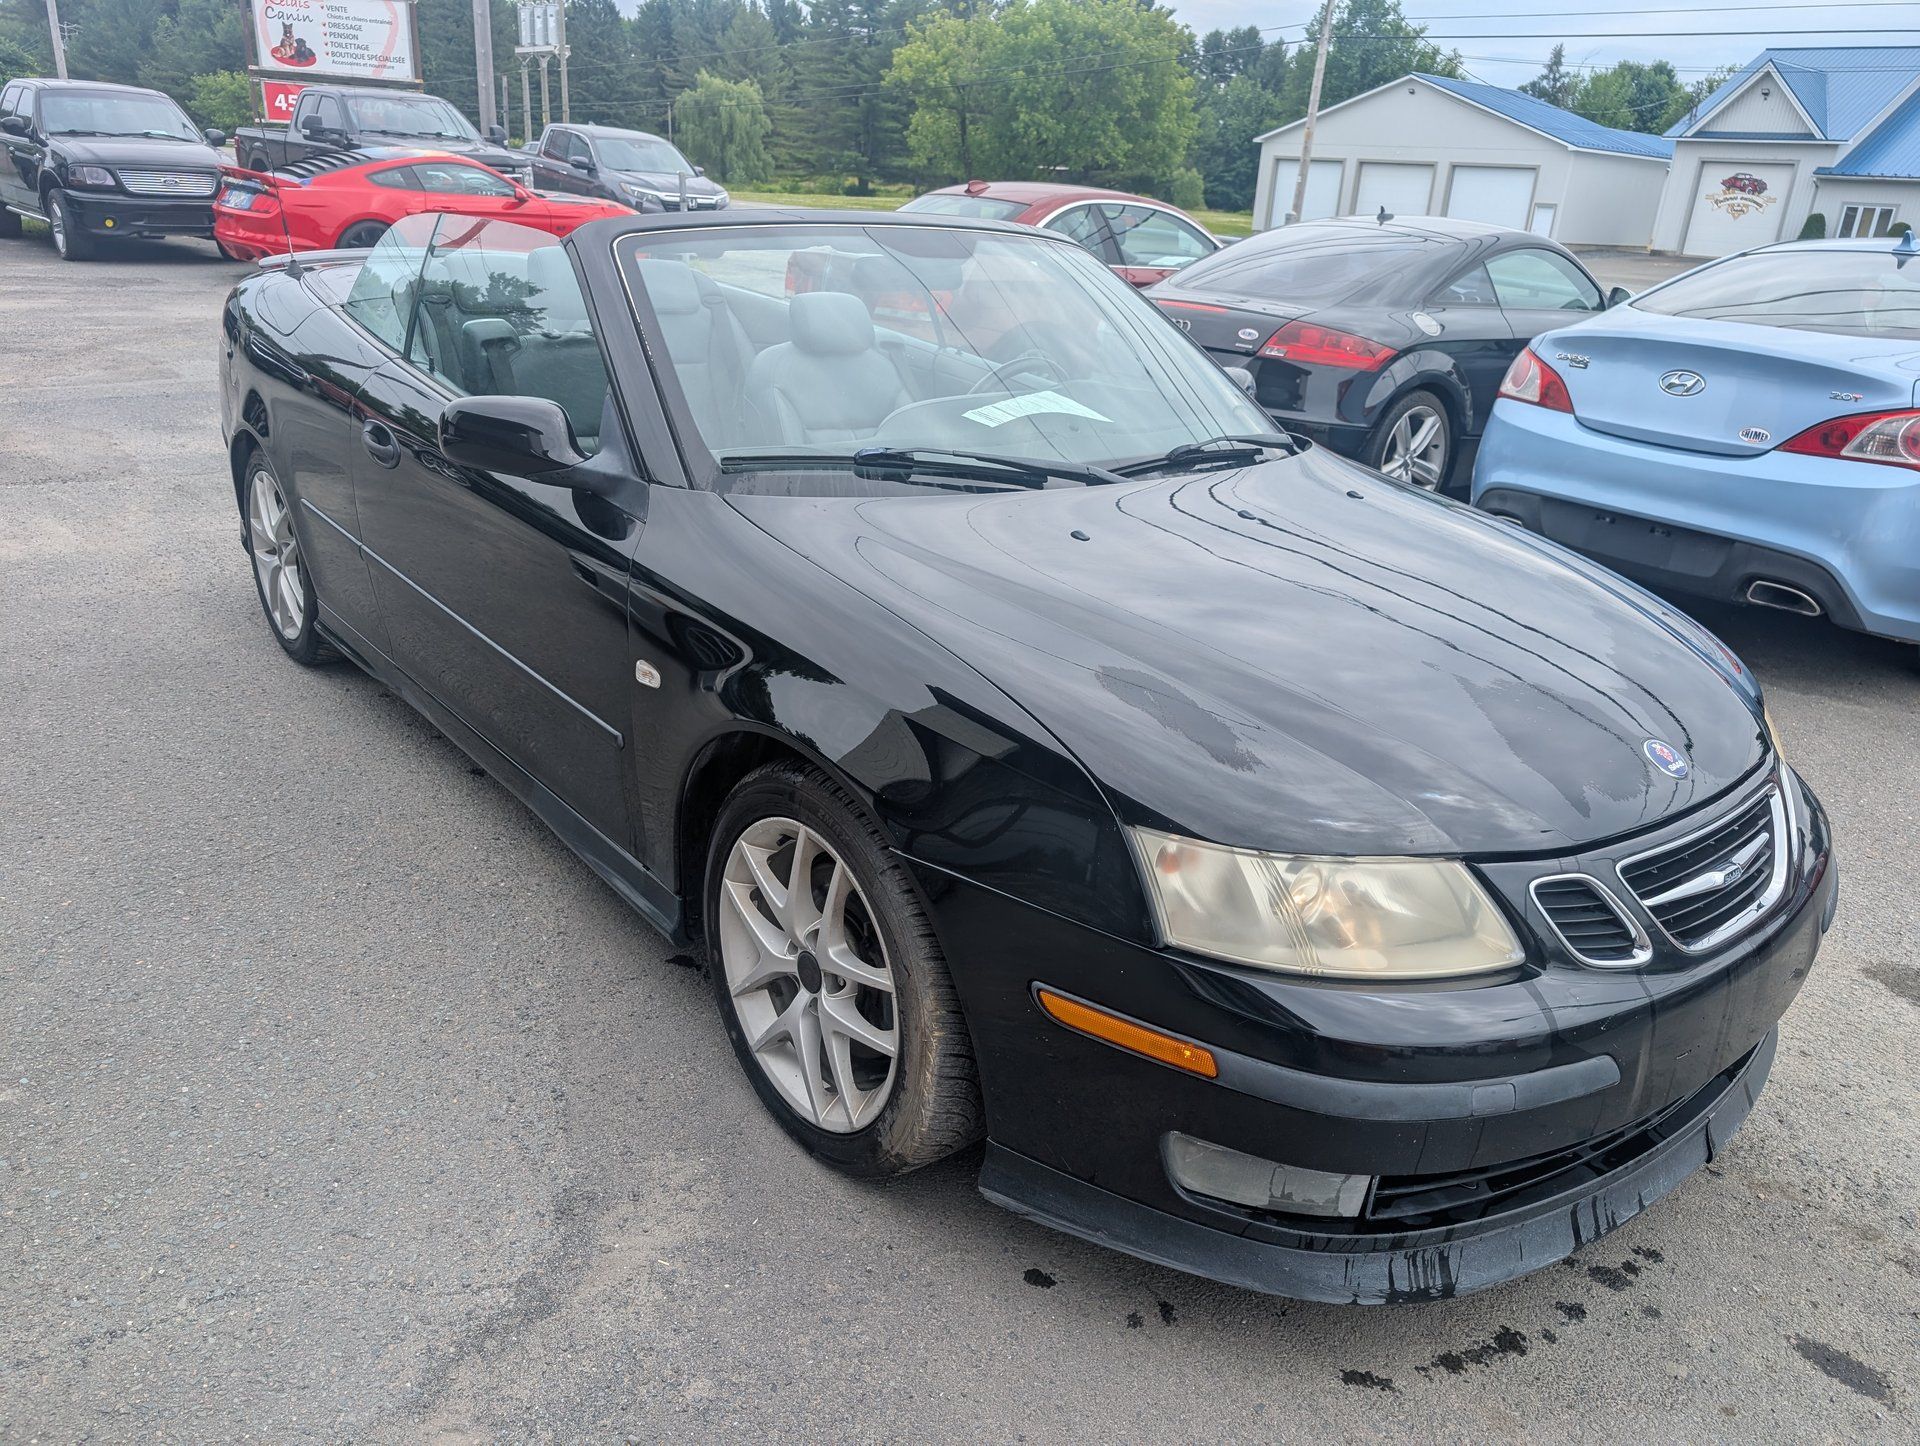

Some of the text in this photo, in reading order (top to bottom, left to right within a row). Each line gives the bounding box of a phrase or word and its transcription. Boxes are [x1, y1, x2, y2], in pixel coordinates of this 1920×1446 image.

[326, 5, 348, 13] VENTE
[265, 6, 313, 22] Canin
[328, 22, 363, 31] DRESSAGE
[329, 32, 359, 40] PENSION
[330, 41, 370, 51] TOILETTAGE
[331, 51, 366, 60] BOUTIQUE
[1556, 352, 1591, 363] GENESIS
